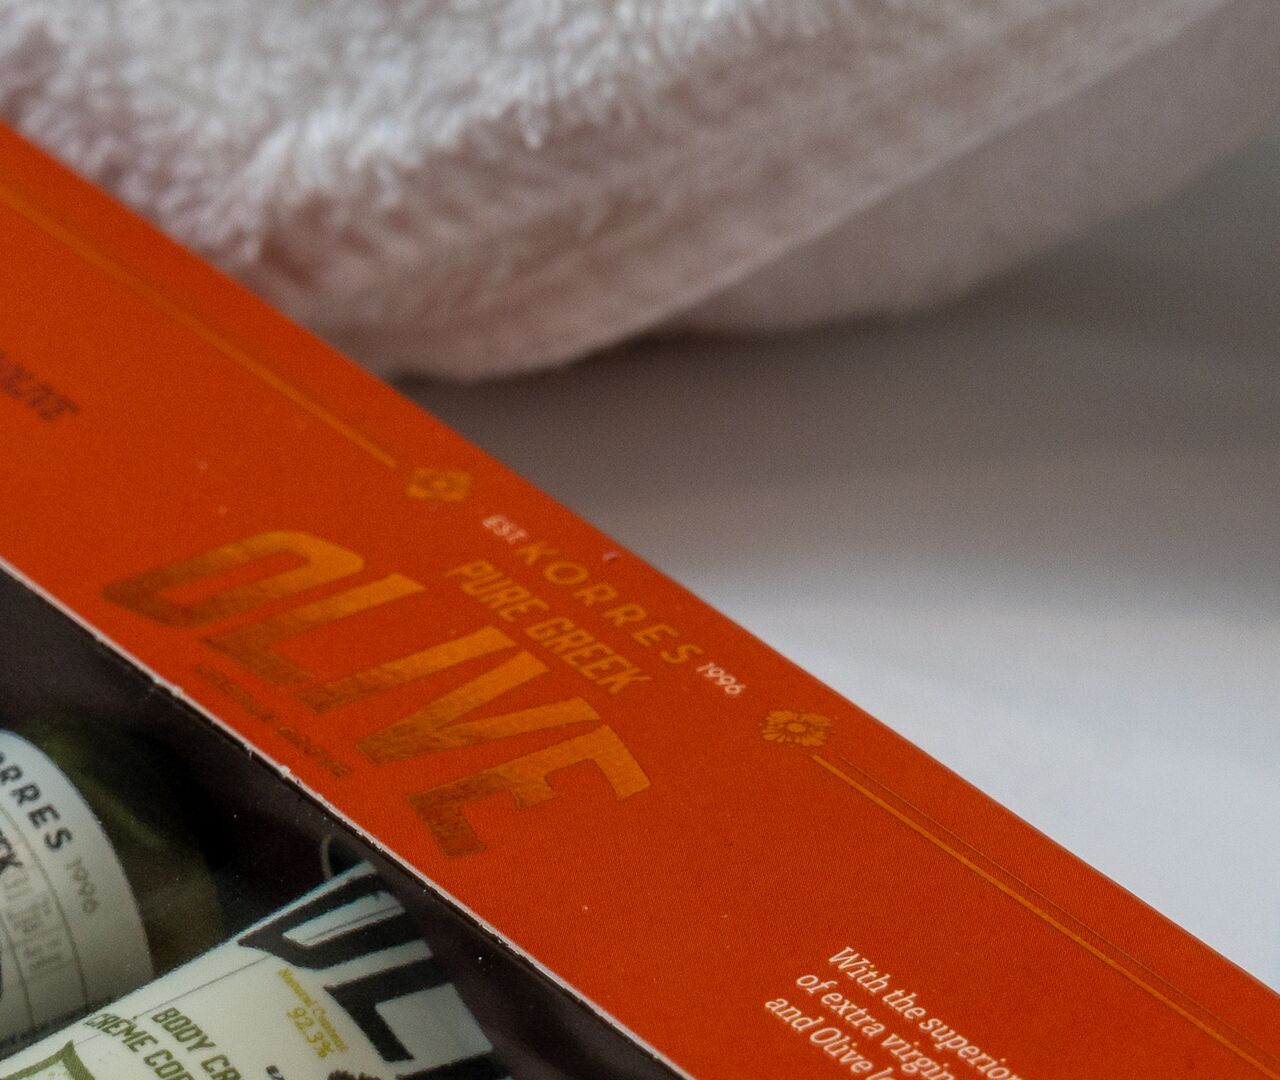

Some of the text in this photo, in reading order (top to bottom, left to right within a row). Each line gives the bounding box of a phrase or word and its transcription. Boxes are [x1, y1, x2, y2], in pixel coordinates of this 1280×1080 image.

[446, 560, 652, 694] PURE GREEK
[514, 541, 705, 667] KORRES
[696, 662, 747, 697] 1996
[101, 530, 651, 860] OLIVE
[795, 973, 839, 996] of
[820, 991, 886, 1038] extra
[828, 946, 891, 994] With
[882, 987, 927, 1020] the
[151, 1007, 217, 1053] BODY
[287, 1006, 334, 1059] 92.3%
[764, 997, 825, 1032] and
[809, 1026, 874, 1074] Olive
